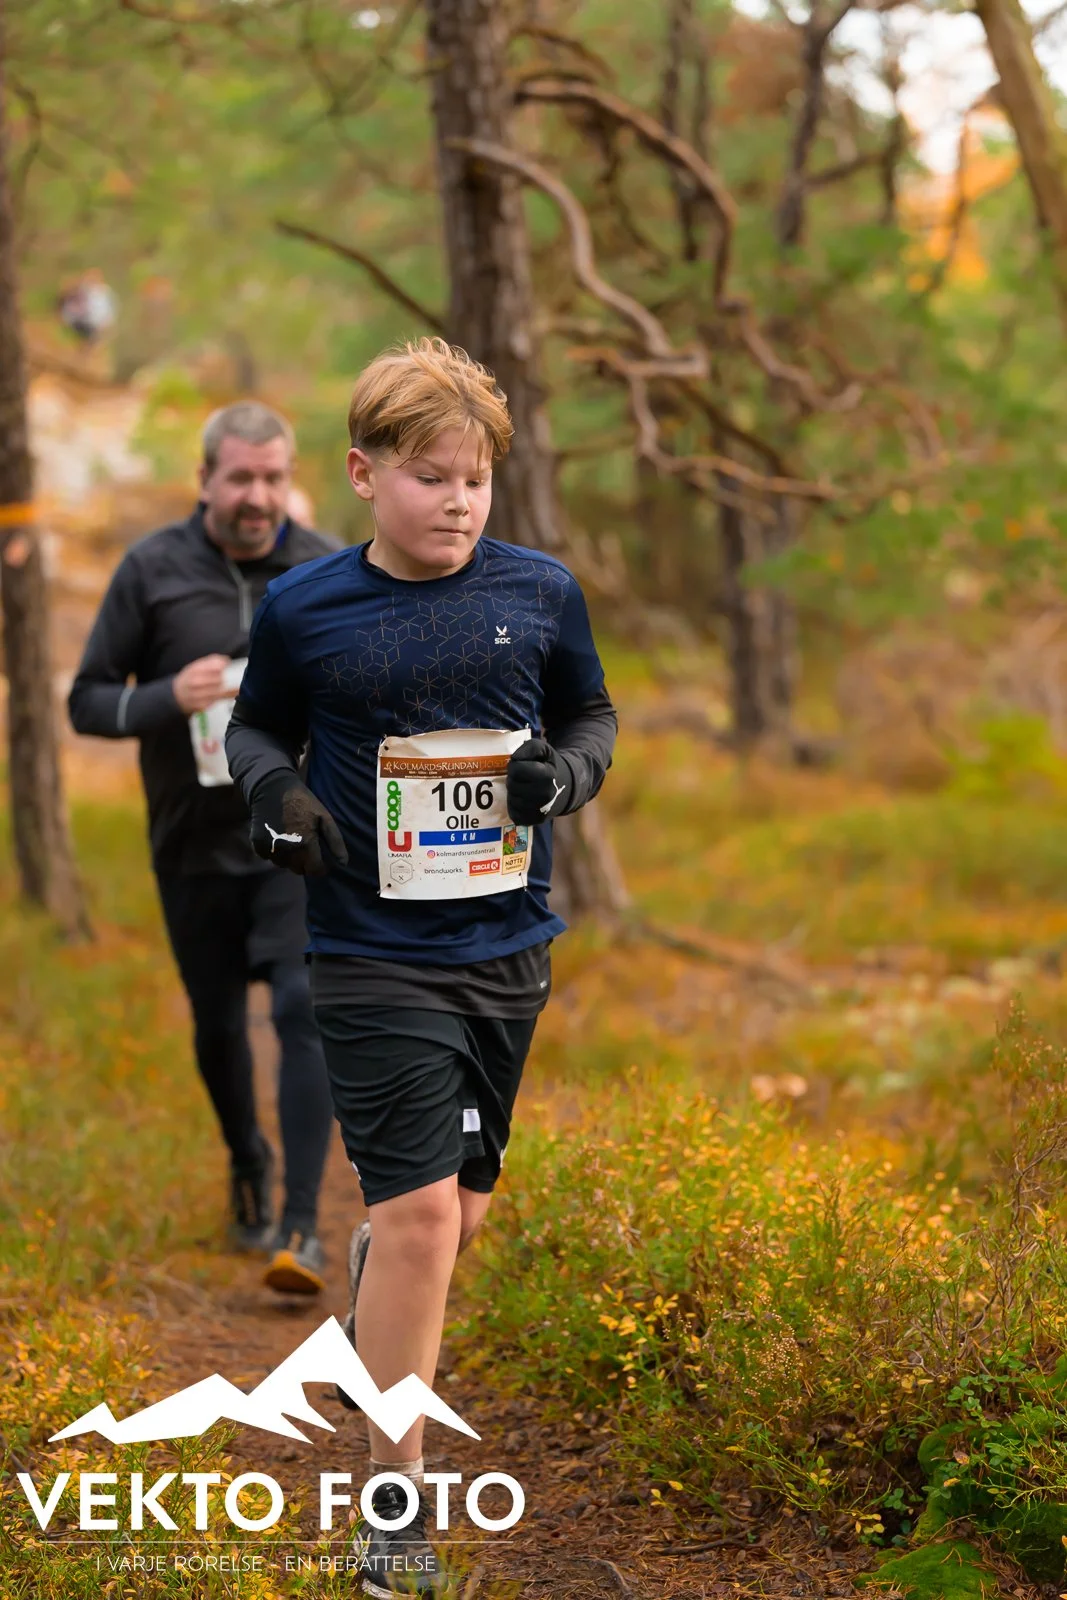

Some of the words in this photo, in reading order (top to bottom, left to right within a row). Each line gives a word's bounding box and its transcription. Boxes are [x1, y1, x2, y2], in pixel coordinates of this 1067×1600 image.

[494, 637, 511, 645] SOC
[431, 780, 494, 811] 106
[387, 781, 401, 831] coop
[446, 815, 480, 830] Olle
[450, 833, 456, 842] 6
[436, 848, 496, 857] kolmardsrundantrail
[490, 861, 499, 870] K
